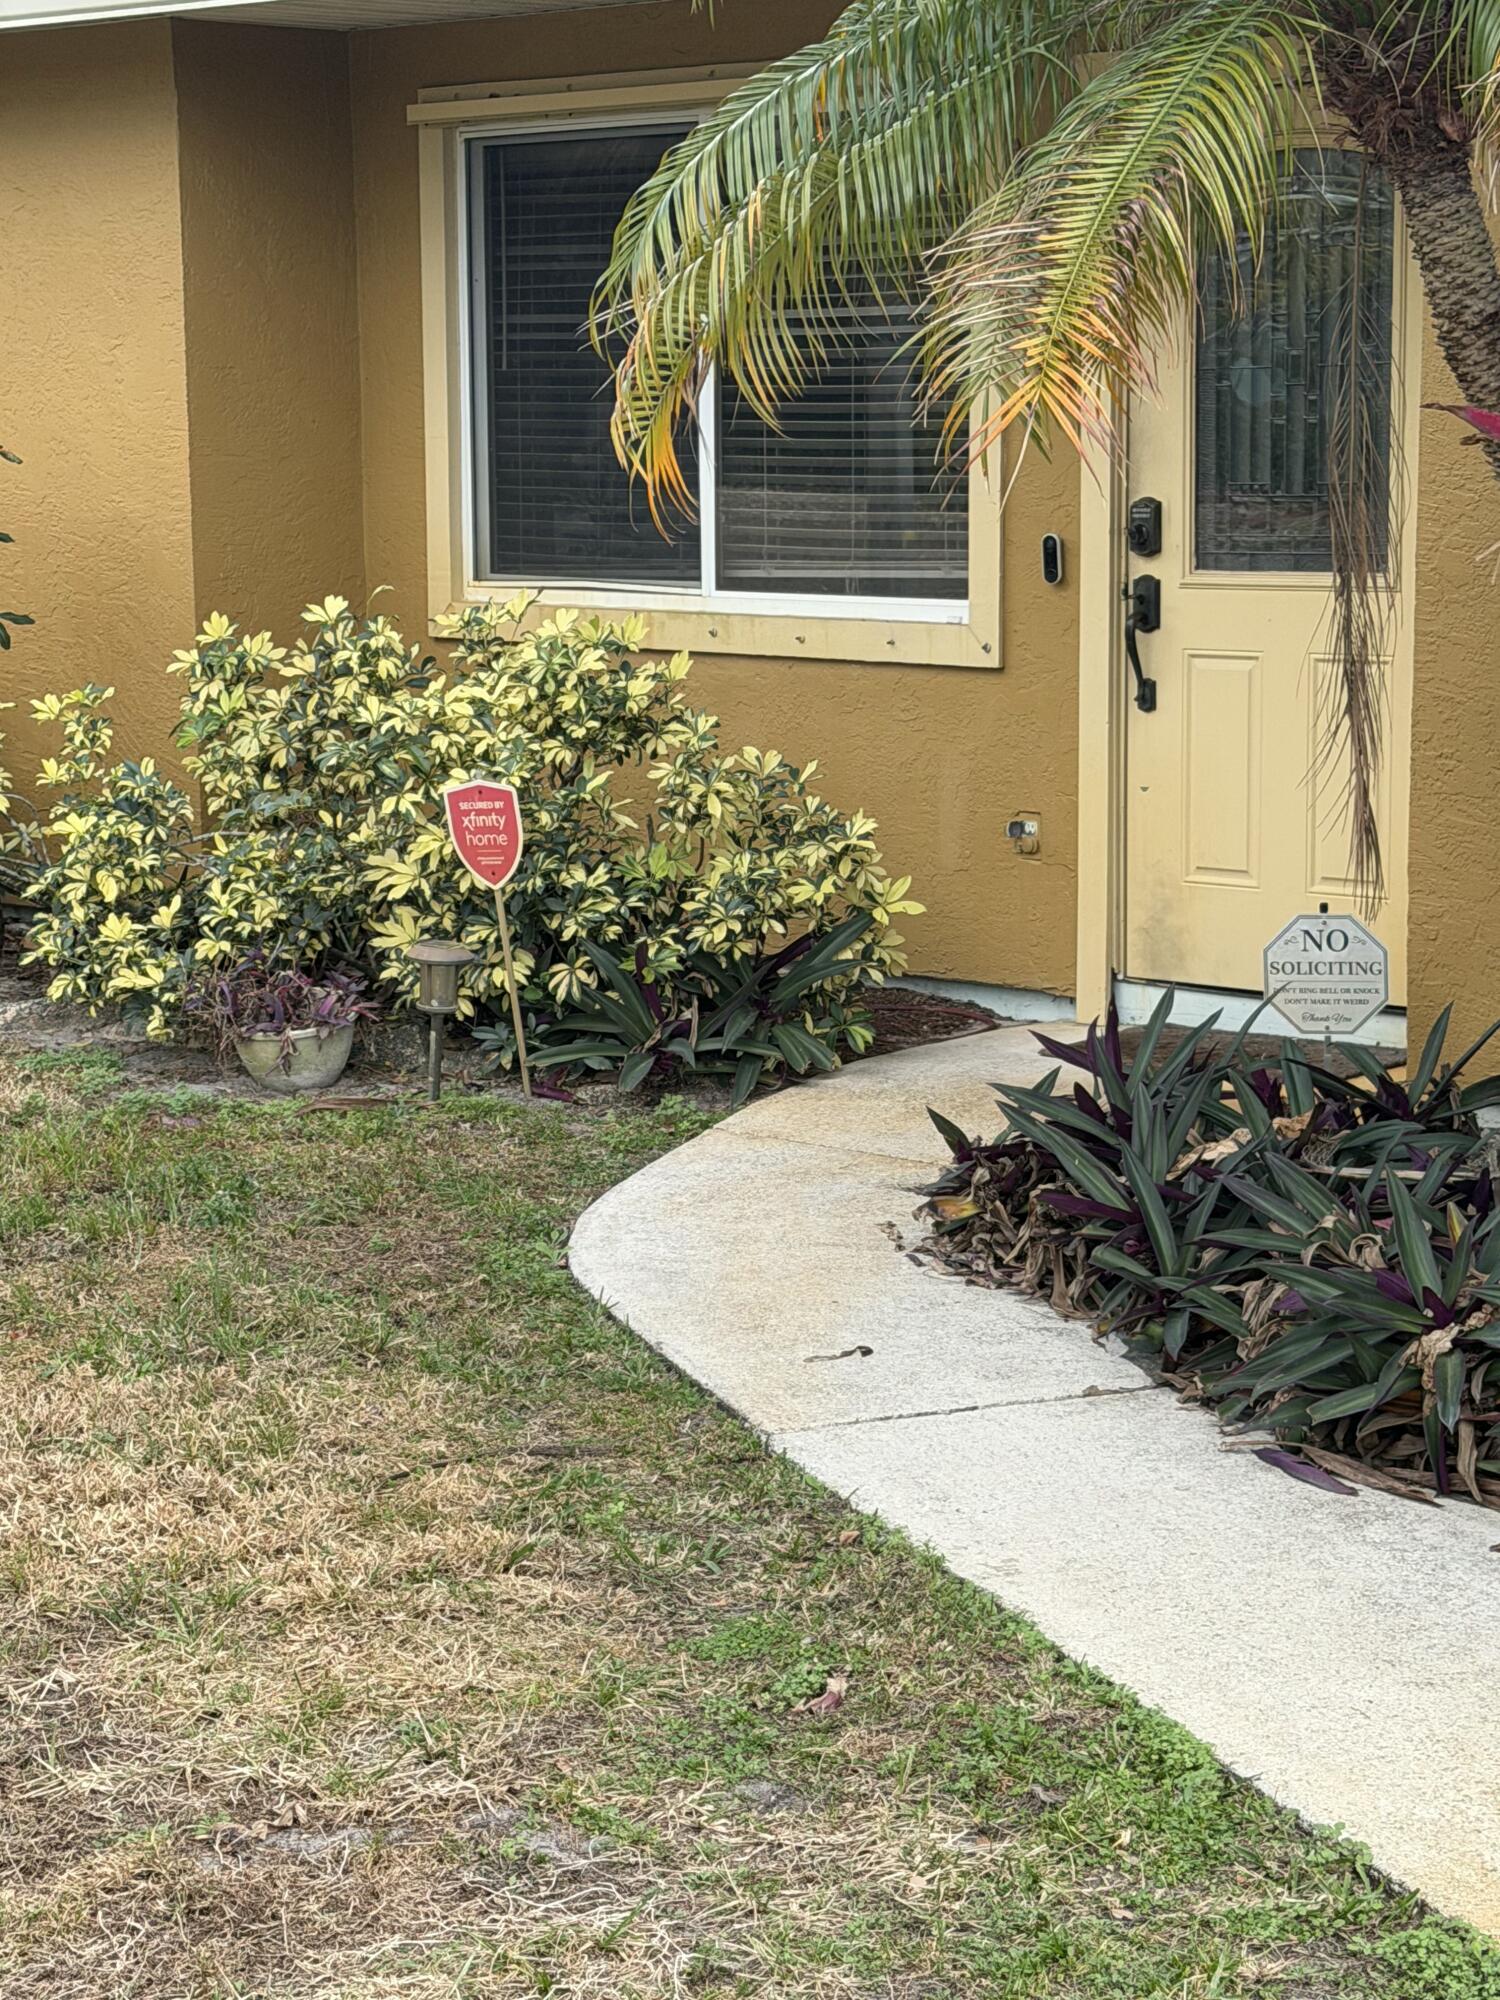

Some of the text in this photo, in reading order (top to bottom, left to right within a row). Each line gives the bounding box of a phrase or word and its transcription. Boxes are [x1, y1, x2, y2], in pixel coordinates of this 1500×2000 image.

[458, 800, 504, 810] SECURED BY
[461, 811, 506, 831] xfinity
[465, 830, 509, 846] home
[1300, 929, 1349, 952] NO
[1269, 961, 1383, 976] SOLICITING
